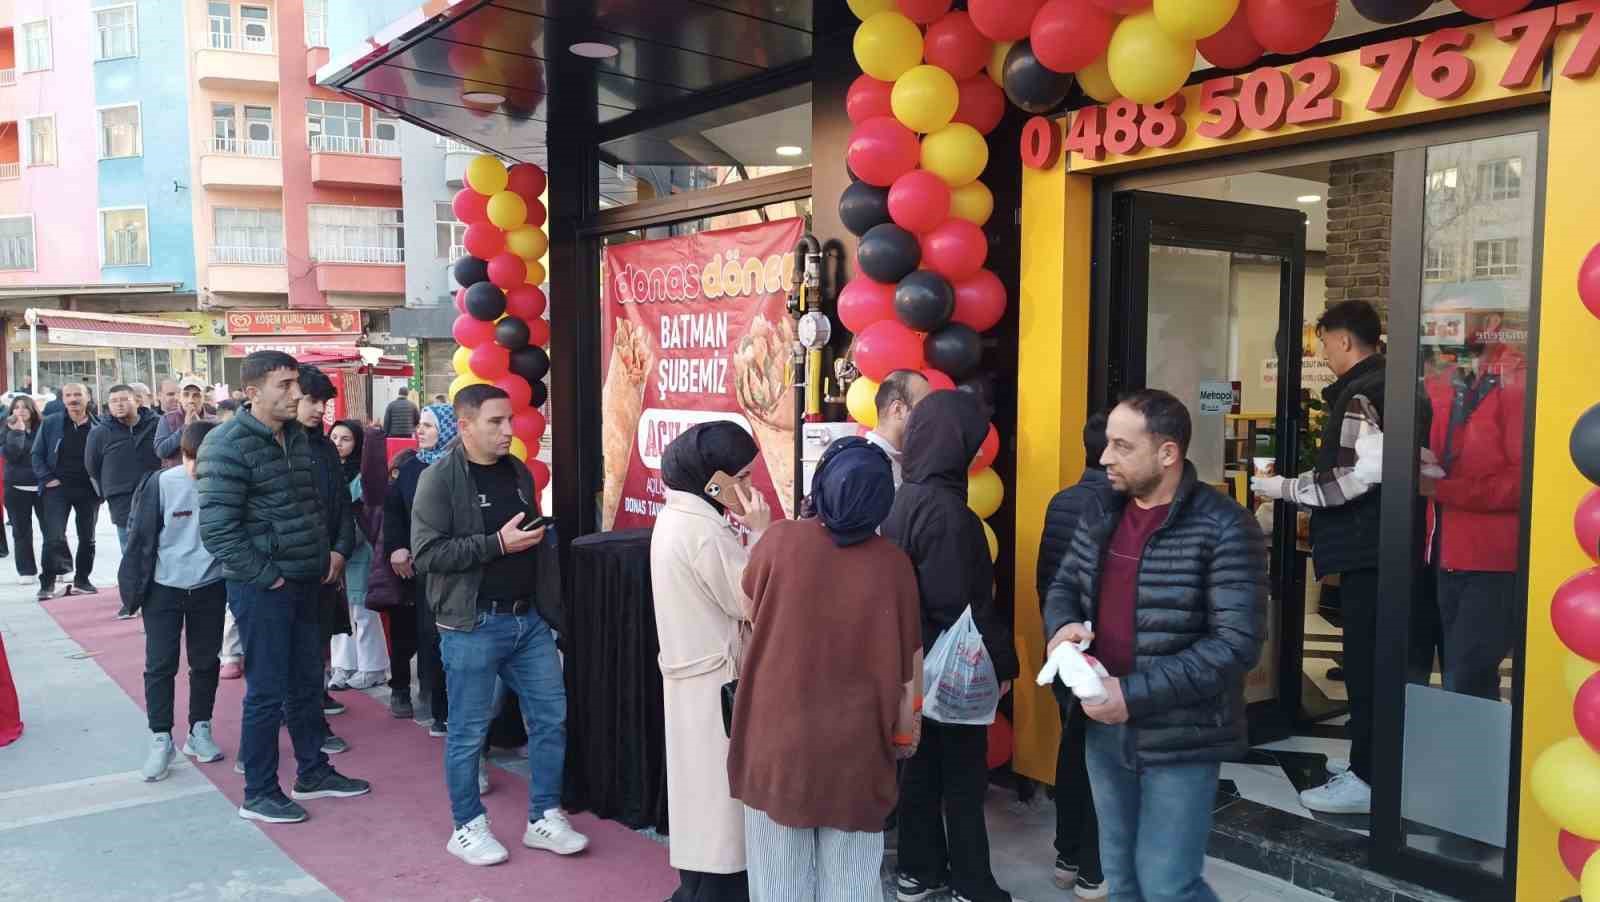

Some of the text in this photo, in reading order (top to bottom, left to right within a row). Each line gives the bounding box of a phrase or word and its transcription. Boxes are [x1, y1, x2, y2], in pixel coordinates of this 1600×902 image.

[1020, 0, 1600, 170] 0 488 502 76 77
[615, 263, 700, 304] donas
[255, 312, 324, 327] KÖŞEM KURUYEMİŞ
[660, 312, 728, 349] BATMAN
[658, 350, 728, 400] ŞUBEMİZ
[1200, 391, 1233, 401] Metropol
[624, 497, 646, 515] DONAS
